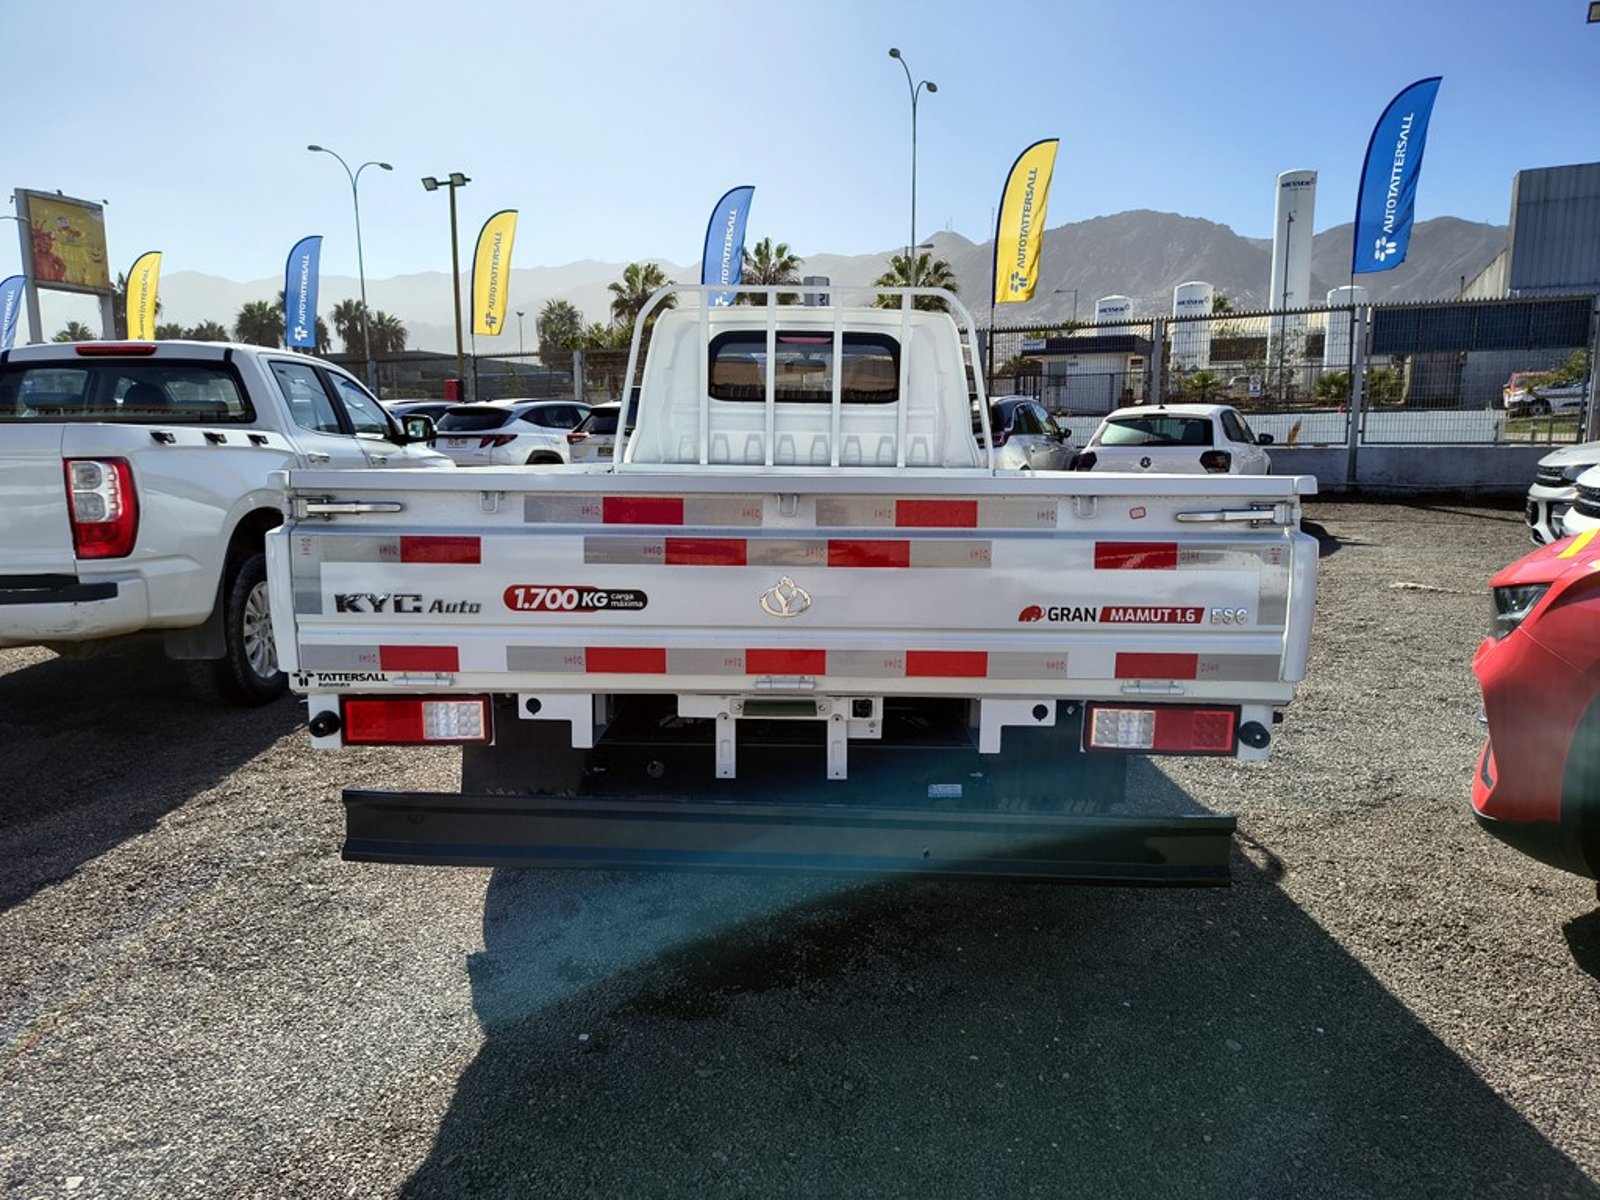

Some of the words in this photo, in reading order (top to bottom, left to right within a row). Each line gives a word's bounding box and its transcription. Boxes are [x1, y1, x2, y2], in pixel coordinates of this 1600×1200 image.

[1384, 113, 1414, 233] AUTOTATTERSALL
[1017, 168, 1038, 269] AUTOTATTERSALL
[488, 232, 502, 310] AUTOTATTERSALL
[299, 254, 310, 325] AUTOTATTERSALL
[334, 593, 423, 613] KYC
[428, 599, 482, 613] Auto
[514, 588, 577, 610] 1.700
[581, 591, 609, 607] KG
[610, 593, 634, 601] carga
[1047, 607, 1096, 622] GRAN
[1109, 608, 1170, 622] MAMUT
[1175, 608, 1195, 622] 1.6
[1210, 608, 1248, 625] ESC
[316, 672, 388, 682] TATTERSALL
